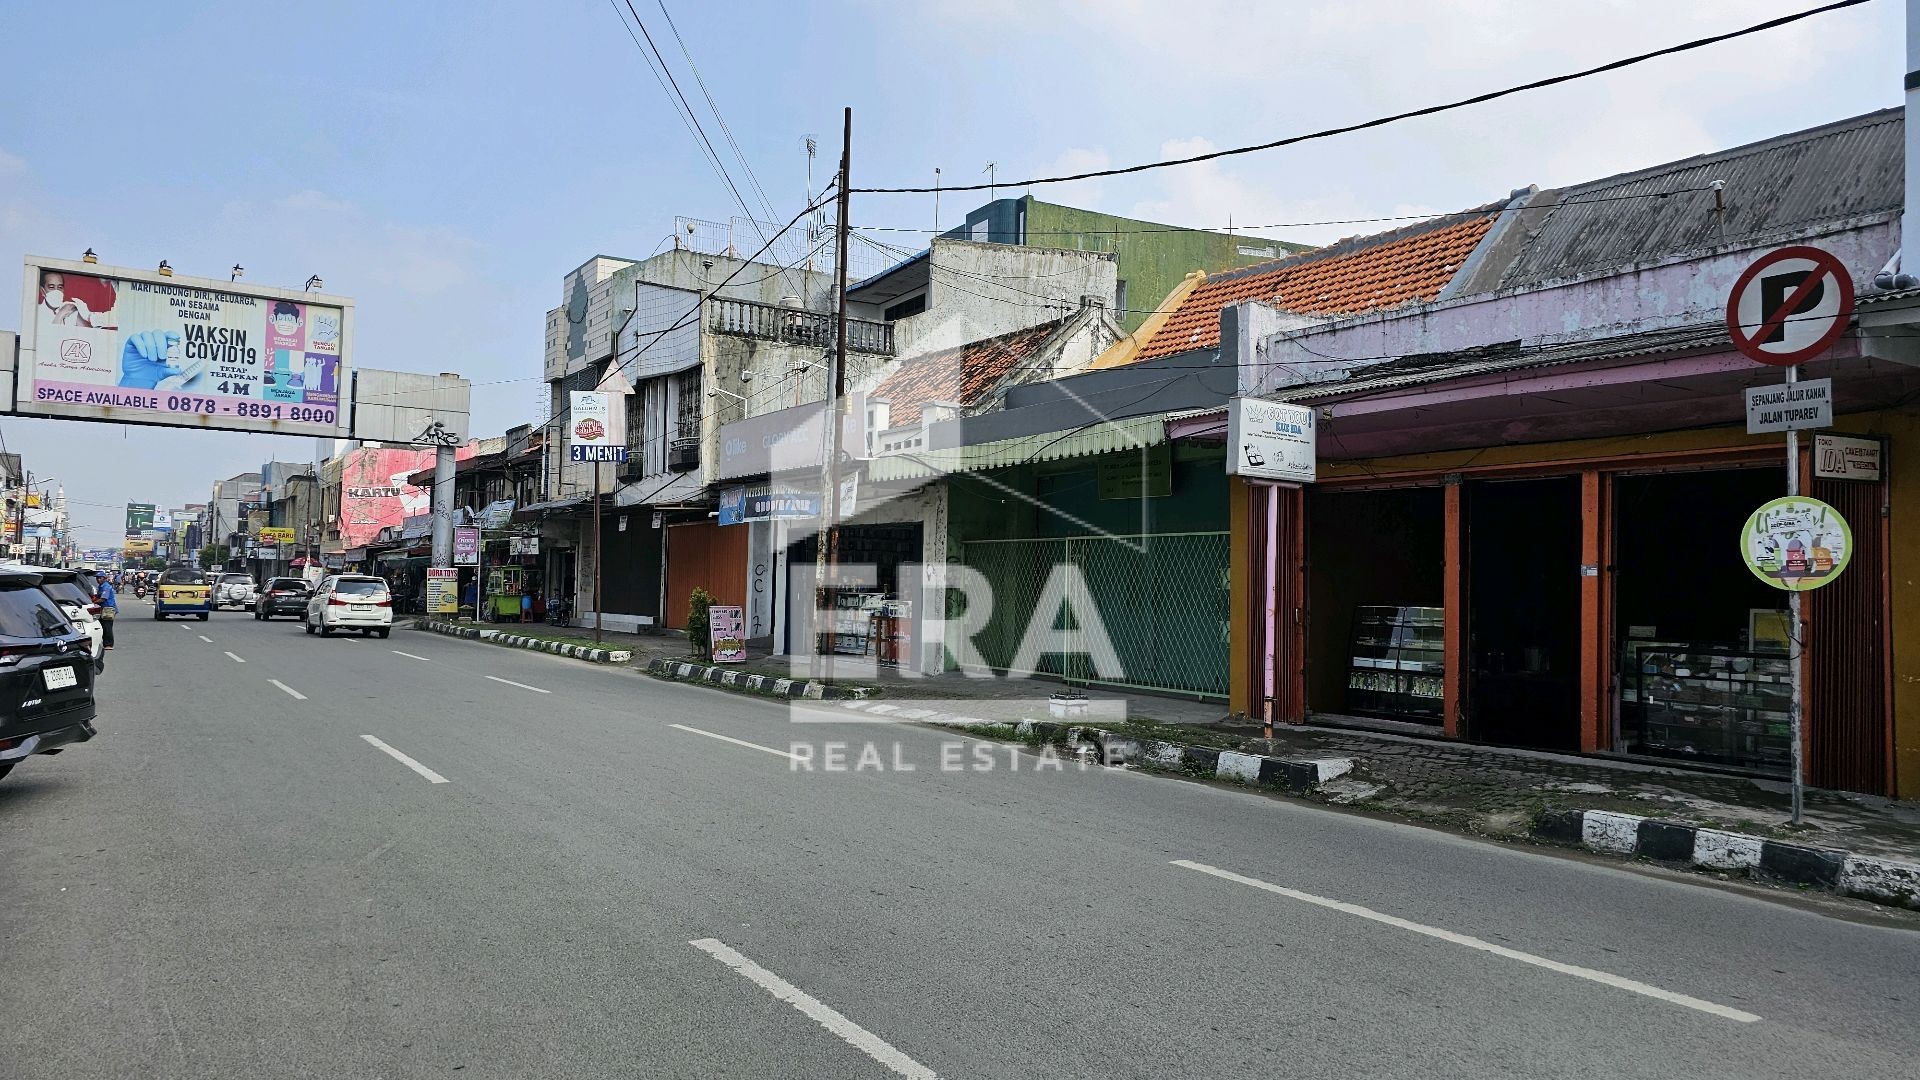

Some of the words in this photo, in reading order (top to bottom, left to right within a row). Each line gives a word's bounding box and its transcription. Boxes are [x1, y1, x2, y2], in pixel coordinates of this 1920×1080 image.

[131, 282, 151, 293] MARI
[153, 284, 192, 298] LINDUNGI
[194, 291, 213, 303] DIRI,
[214, 294, 257, 307] KELUARGA,
[170, 298, 186, 307] DAN
[188, 301, 220, 312] SESAMA
[1761, 271, 1825, 344] P
[178, 310, 211, 321] DENGAN
[184, 323, 247, 347] VAKSIN
[185, 341, 257, 365] COVID19
[210, 371, 258, 381] TERAPKAN
[220, 365, 248, 373] TETAP
[217, 380, 230, 394] 4
[232, 382, 250, 396] M
[1752, 391, 1785, 407] SEPANJANG
[1785, 390, 1805, 402] JALUR
[1805, 387, 1826, 401] KANAN
[37, 387, 83, 402] SPACE
[86, 392, 158, 409] AVAILABLE
[167, 395, 216, 414] 0878
[237, 402, 282, 420] 8891
[290, 407, 335, 424] 8000
[1760, 410, 1783, 425] JALAN
[1784, 407, 1819, 422] TUPAREV
[1817, 438, 1833, 446] TOKO
[573, 446, 581, 461] 3
[585, 446, 625, 461] MENIT
[346, 486, 401, 499] KARTU
[444, 569, 458, 577] TOYS
